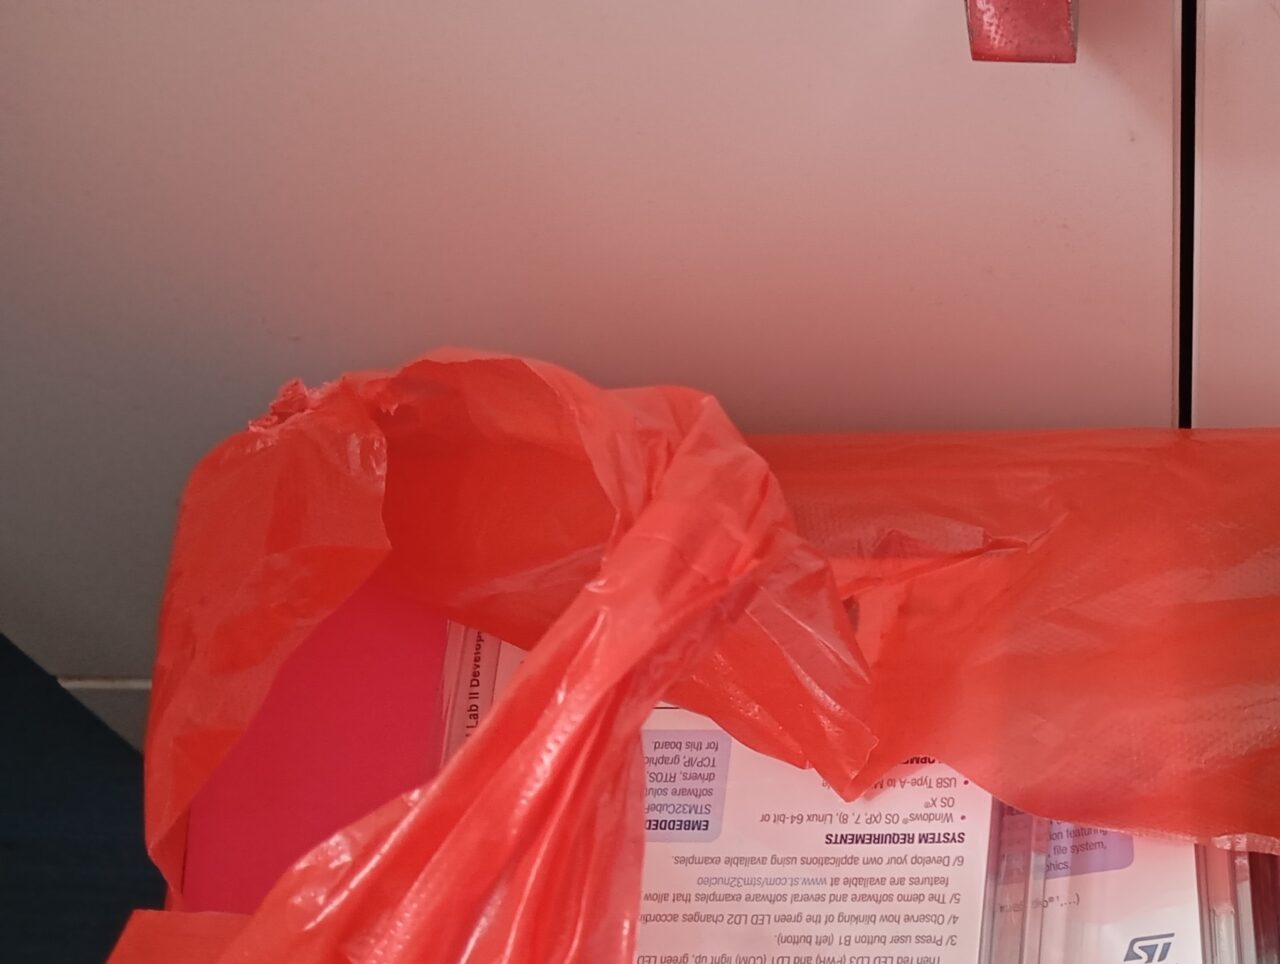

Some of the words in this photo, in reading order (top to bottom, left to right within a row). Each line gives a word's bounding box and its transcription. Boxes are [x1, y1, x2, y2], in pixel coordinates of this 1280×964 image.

[470, 632, 484, 687] Develop
[466, 704, 478, 728] Lab
[651, 741, 682, 751] board.
[685, 741, 702, 751] this
[707, 741, 718, 751] for
[683, 755, 716, 767] TCP/IP,
[647, 771, 676, 782] RTOS,
[680, 771, 715, 782] drivers,
[900, 776, 932, 788] Type-A
[887, 779, 896, 788] to
[936, 778, 957, 788] USB
[645, 787, 667, 798] solut
[667, 787, 713, 798] software
[940, 797, 955, 808] OS
[760, 813, 770, 822] or
[773, 813, 804, 824] 64-bit
[807, 813, 833, 824] Linux
[836, 812, 848, 824] 8),
[852, 813, 861, 824] 7,
[885, 813, 900, 824] OS
[825, 832, 915, 844] REQUIREMENTS
[918, 832, 965, 844] SYSTEM
[1053, 845, 1067, 855] file
[1070, 840, 1107, 854] system,
[672, 854, 721, 867] examples.
[724, 856, 767, 867] available
[771, 854, 797, 866] using
[800, 855, 859, 868] applications
[862, 856, 883, 866] own
[886, 854, 908, 865] your
[911, 854, 950, 866] Develop
[952, 856, 964, 866] 6/
[697, 876, 827, 888] www.st.com/stm32nucleo
[830, 877, 840, 887] at
[843, 877, 886, 888] available
[890, 877, 906, 886] are
[909, 877, 949, 887] features
[644, 893, 669, 904] allow
[673, 893, 691, 904] that
[695, 891, 742, 903] examples
[745, 893, 788, 904] software
[790, 893, 826, 903] several
[829, 893, 848, 904] and
[852, 893, 894, 904] software
[897, 893, 921, 904] demo
[925, 893, 946, 904] The
[949, 893, 960, 904] 5/
[682, 912, 724, 924] changes
[727, 914, 748, 924] LD2
[751, 914, 771, 924] LED
[774, 912, 803, 923] green
[805, 914, 821, 925] the
[823, 914, 834, 925] of
[838, 912, 876, 925] blinking
[879, 914, 900, 925] how
[904, 914, 945, 925] Observe
[947, 914, 959, 925] 4/
[774, 934, 812, 946] button).
[815, 934, 833, 946] (left
[838, 935, 851, 945] B1
[855, 935, 886, 946] button
[890, 935, 911, 944] user
[915, 935, 943, 946] Press
[946, 935, 957, 946] 3/
[660, 953, 688, 964] green
[692, 953, 707, 964] up,
